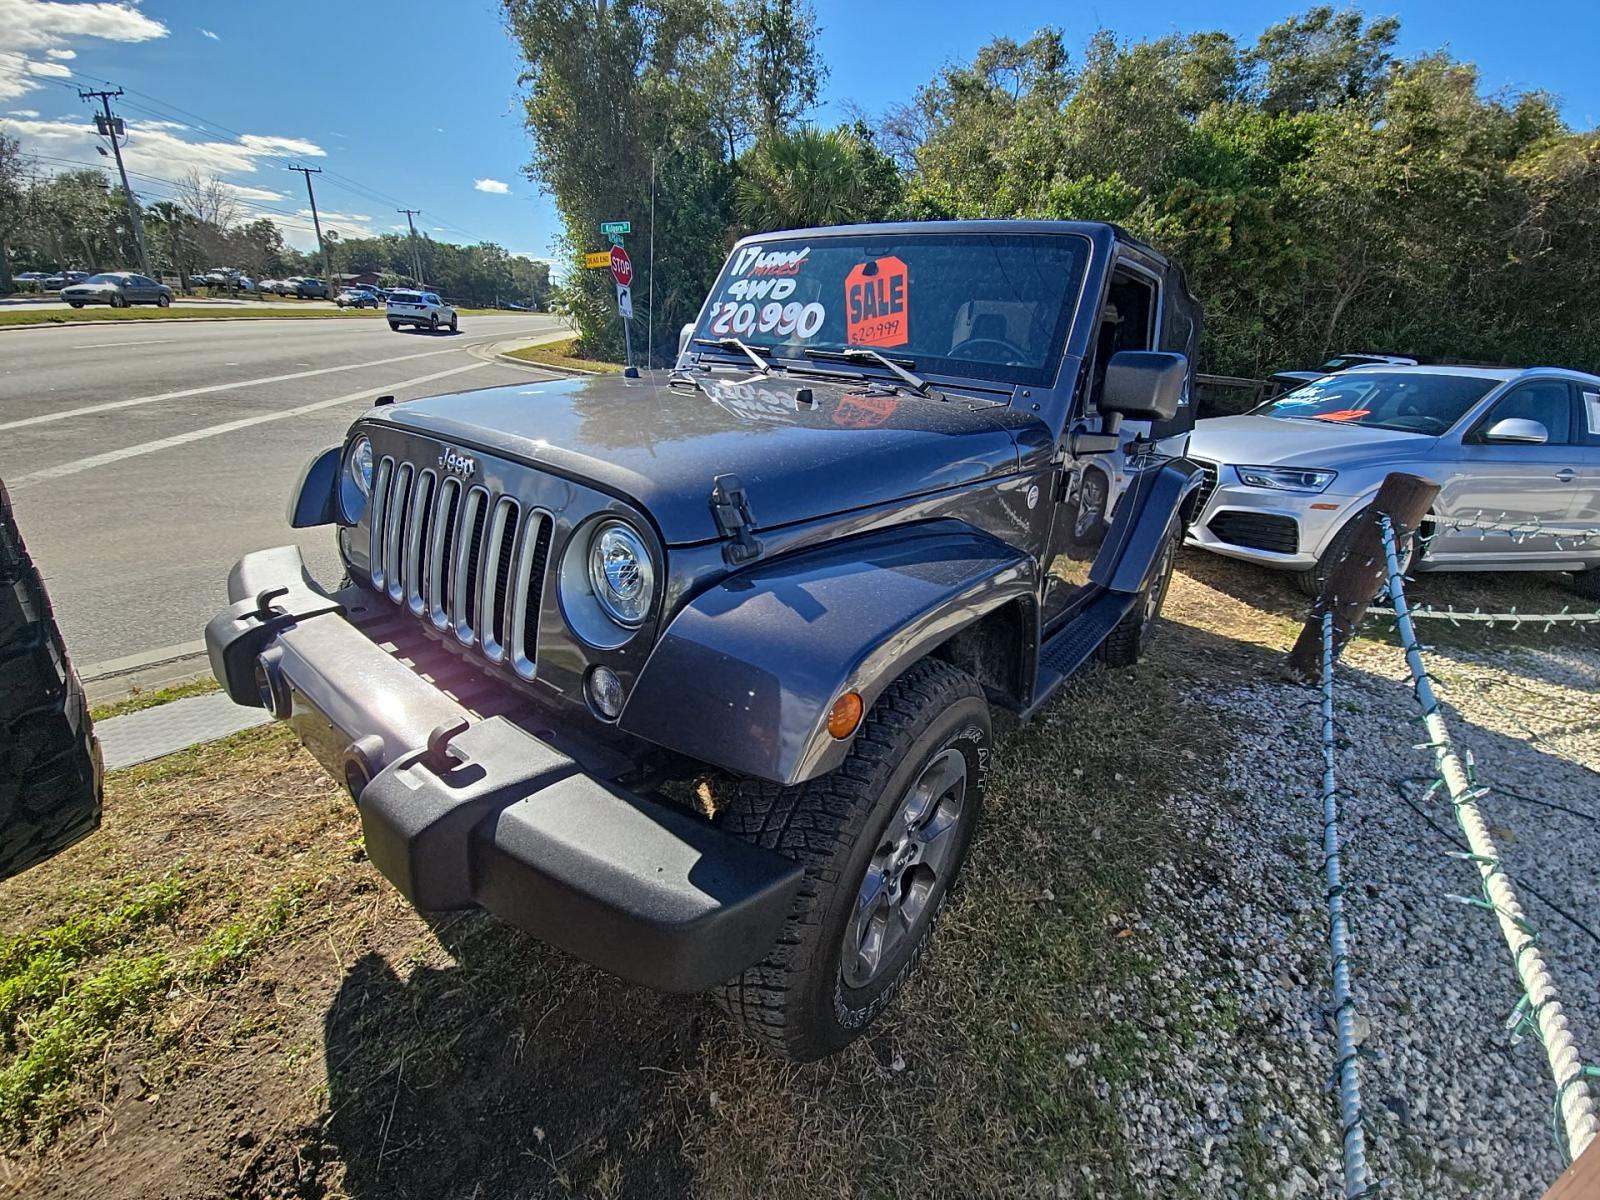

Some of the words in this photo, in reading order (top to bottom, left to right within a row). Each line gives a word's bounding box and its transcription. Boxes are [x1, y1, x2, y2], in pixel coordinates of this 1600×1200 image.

[612, 256, 630, 275] STOP
[730, 245, 763, 276] 17
[727, 277, 797, 301] 4WD
[850, 274, 904, 324] SALE
[710, 301, 826, 339] $20,990
[851, 319, 900, 342] $20,999
[438, 447, 475, 482] Jeep
